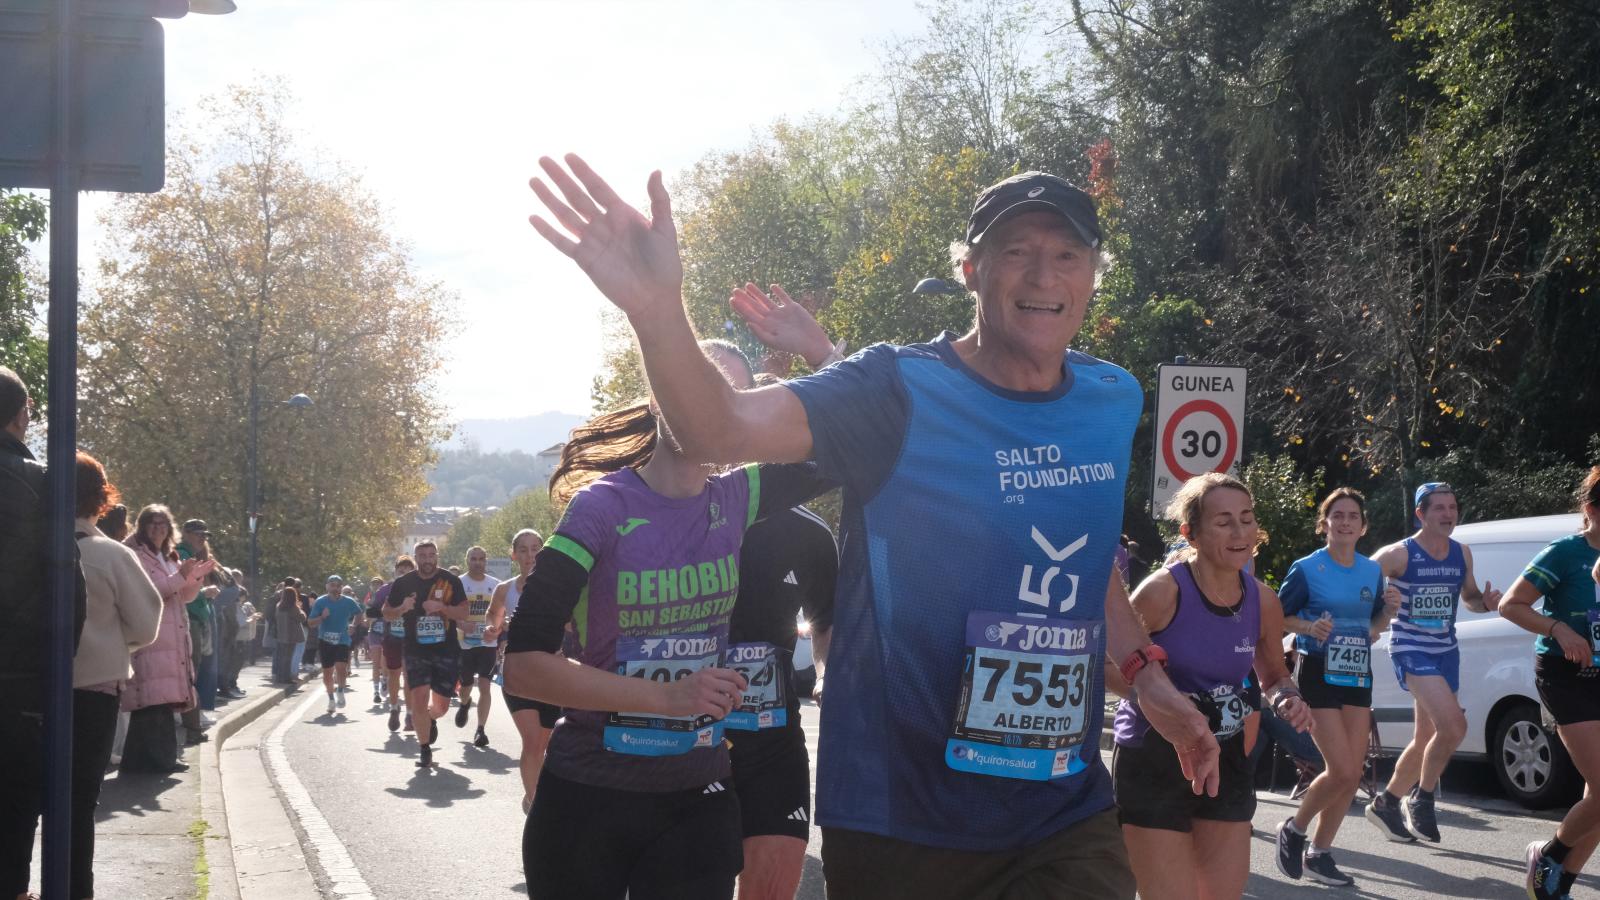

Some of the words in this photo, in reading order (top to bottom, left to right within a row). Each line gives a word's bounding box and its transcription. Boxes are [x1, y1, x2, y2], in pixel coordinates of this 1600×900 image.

[1171, 376, 1234, 391] GUNEA
[1181, 430, 1221, 458] 30
[995, 445, 1061, 467] SALTO
[1000, 462, 1115, 491] FOUNDATION
[1003, 492, 1024, 504] .org
[617, 553, 739, 605] BEHOBIA
[1017, 525, 1089, 618] 5K
[1414, 595, 1451, 609] 8060
[418, 621, 443, 631] 9530
[619, 609, 655, 628] SAN
[1330, 647, 1368, 664] 7487
[979, 656, 1085, 709] 7553
[993, 712, 1071, 732] ALBERTO
